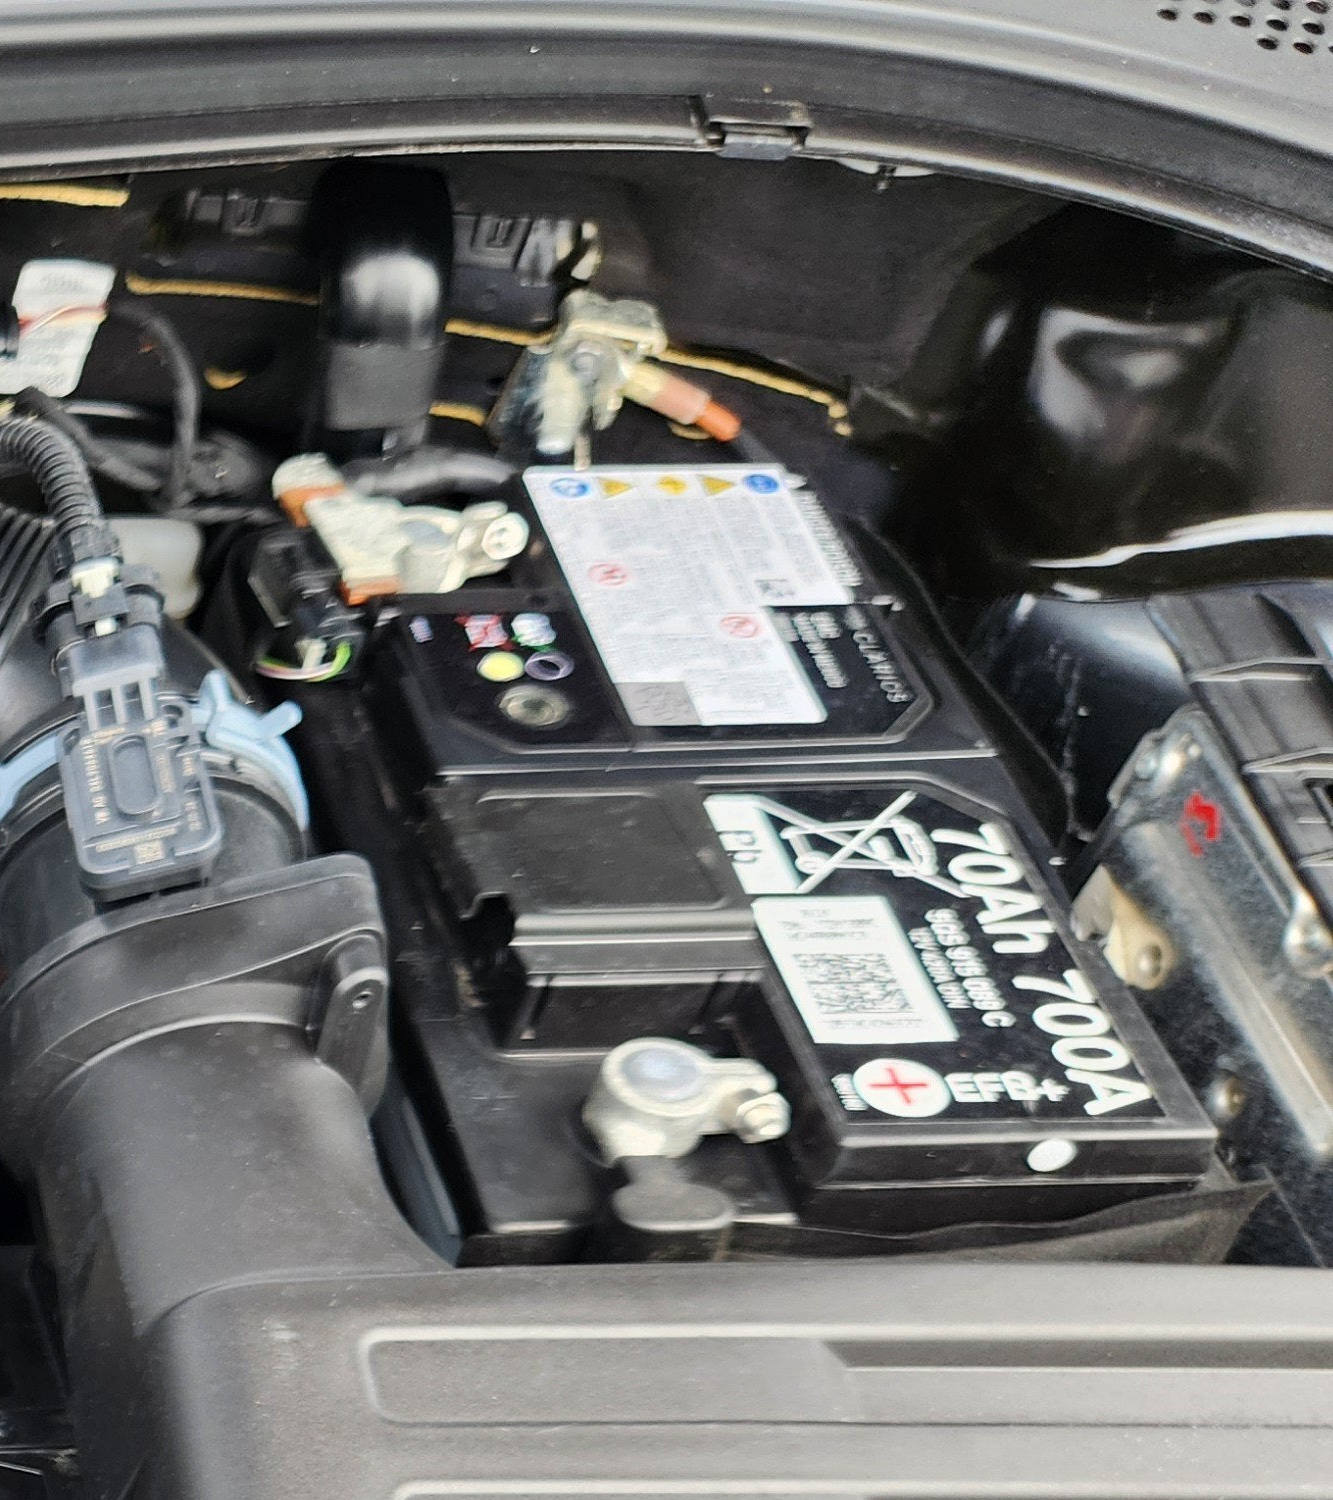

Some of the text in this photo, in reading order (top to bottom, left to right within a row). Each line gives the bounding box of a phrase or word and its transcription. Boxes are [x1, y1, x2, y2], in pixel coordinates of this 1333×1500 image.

[931, 822, 1153, 1115] 70Ah 700A
[945, 1069, 1070, 1102] EFB+
